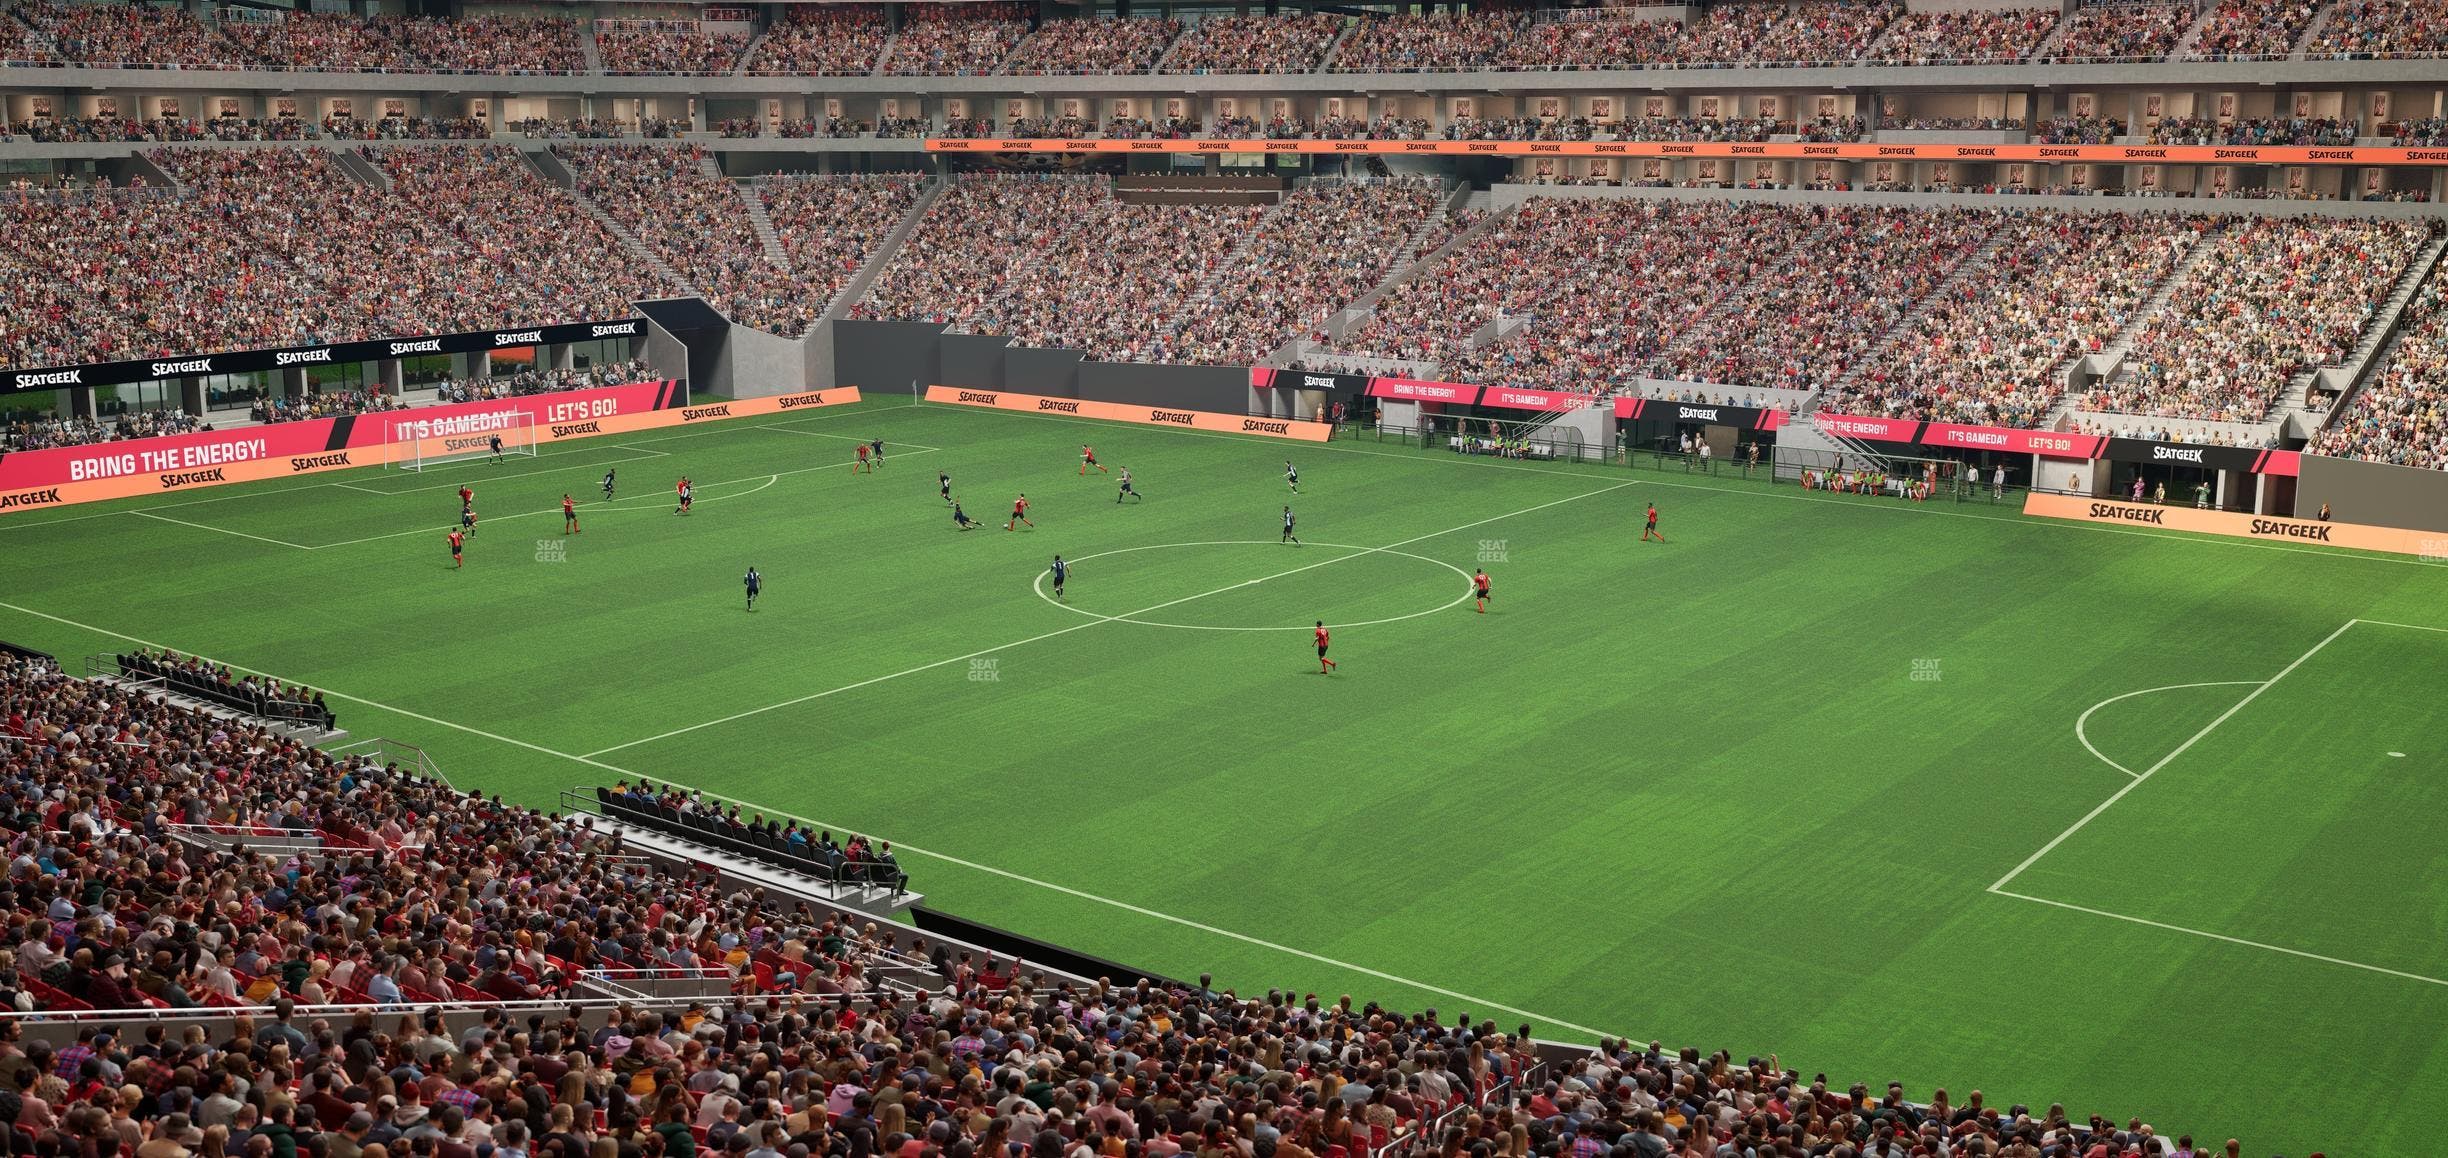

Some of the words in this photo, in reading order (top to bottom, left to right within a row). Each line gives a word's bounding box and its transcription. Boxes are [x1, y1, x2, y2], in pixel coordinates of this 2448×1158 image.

[939, 141, 969, 149] SEATGEEK
[1002, 141, 1033, 149] SEATGEEK
[1131, 142, 1163, 150] SEATGEEK
[1198, 142, 1230, 150] SEATGEEK
[1265, 142, 1299, 150] SEATGEEK
[1335, 142, 1369, 151] SEATGEEK
[1406, 143, 1437, 151] SEATGEEK
[1468, 143, 1498, 152] SEATGEEK
[1530, 144, 1561, 152] SEATGEEK
[1594, 144, 1626, 153] SEATGEEK
[1661, 144, 1695, 153] SEATGEEK
[1731, 145, 1765, 154] SEATGEEK
[1803, 146, 1839, 155] SEATGEEK
[1878, 146, 1916, 156] SEATGEEK
[1957, 147, 1996, 157] SEATGEEK
[2039, 148, 2080, 157] SEATGEEK
[2124, 148, 2167, 158] SEATGEEK
[2214, 149, 2258, 159] SEATGEEK
[2308, 150, 2354, 160] SEATGEEK
[2406, 150, 2448, 161] SEATGEE
[592, 322, 636, 337] SEATGEEK
[495, 330, 542, 345] SEATGEEK
[390, 338, 441, 355] SEATGEEK
[276, 348, 332, 365] SEATGEEK
[152, 358, 212, 376] SEATGEEK
[16, 369, 81, 388] SEATGEEK
[1304, 375, 1335, 389] SEATGEEK
[958, 390, 997, 406] SEATGEEK
[1394, 384, 1414, 395] BRING
[1415, 386, 1427, 396] THE
[1428, 386, 1455, 398] ENERGY!
[779, 393, 823, 409] SEATGEEK
[1038, 398, 1079, 414] SEATGEEK
[1502, 393, 1514, 403] IT'S
[1515, 394, 1548, 406] GAMEDAY
[548, 400, 588, 423] LET'S
[591, 398, 617, 417] GO!
[682, 405, 730, 421] SEATGEEK
[1679, 406, 1717, 422] SEATGEEK
[1150, 410, 1195, 426] SEATGEEK
[397, 420, 429, 441] IT'S
[433, 411, 511, 437] GAMEDAY
[551, 420, 601, 438] SEATGEEK
[1242, 418, 1289, 435] SEATGEEK
[1837, 421, 1851, 432] THE
[1853, 423, 1888, 435] ENERGY!
[1948, 430, 1965, 442] IT'S
[1966, 432, 2008, 446] GAMEDAY
[2028, 437, 2054, 450] LET'S
[2055, 438, 2071, 451] GO!
[70, 453, 135, 481] BRING
[140, 448, 180, 472] THE
[183, 438, 266, 467] ENERGY!
[2153, 445, 2203, 463] SEATGEEK
[291, 452, 351, 471] SEATGEEK
[160, 467, 226, 488] SEATGEEK
[0, 488, 62, 509] ATGEEK
[2089, 502, 2165, 525] SEATGEEK
[2250, 519, 2332, 542] SEATGEEK
